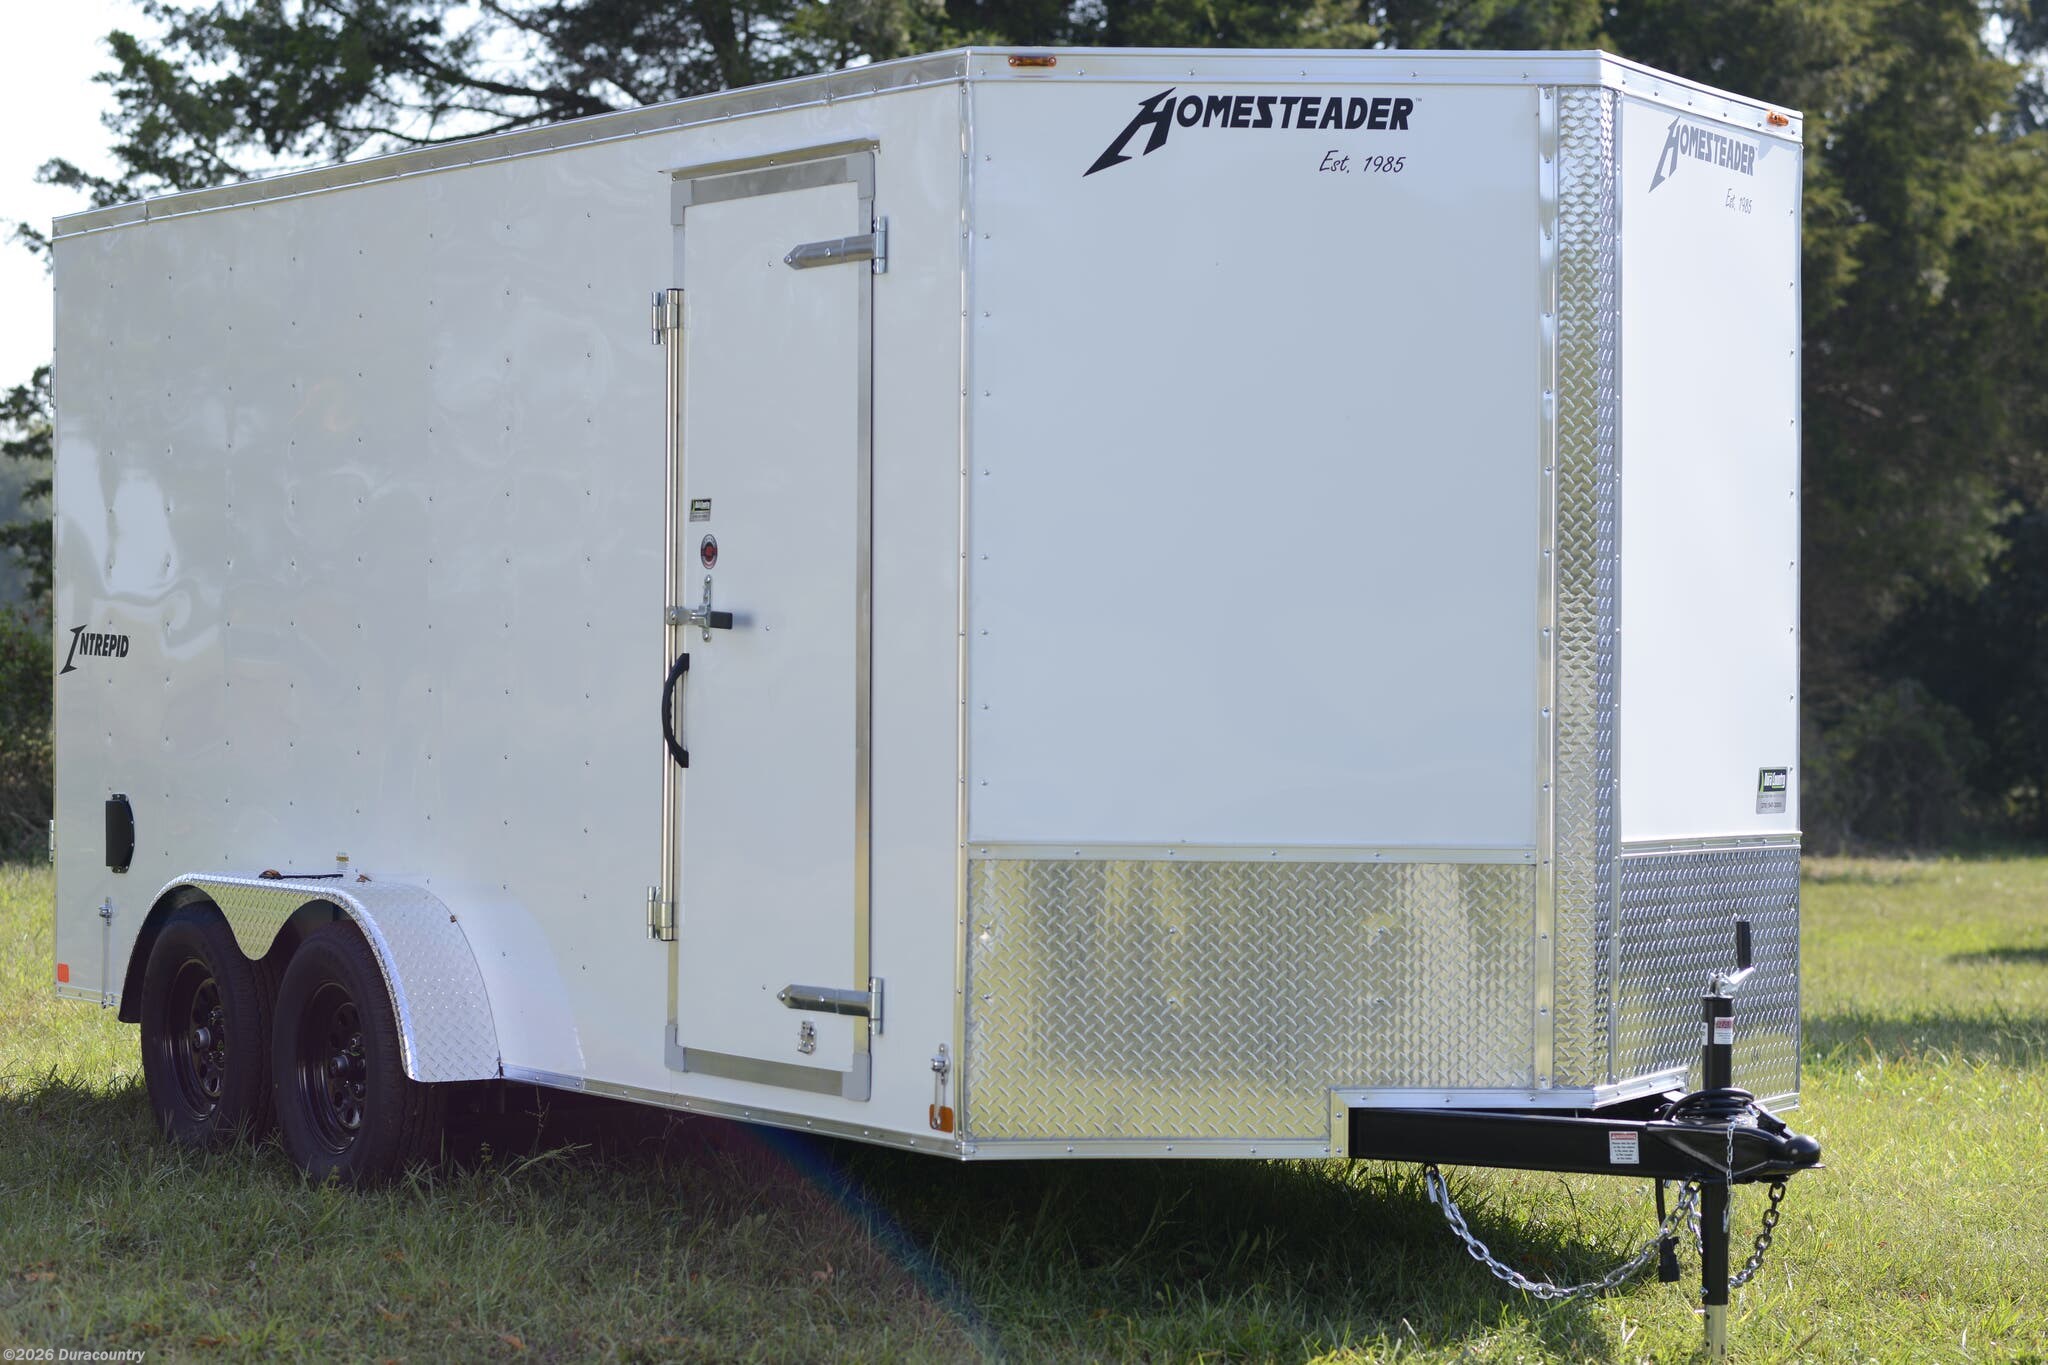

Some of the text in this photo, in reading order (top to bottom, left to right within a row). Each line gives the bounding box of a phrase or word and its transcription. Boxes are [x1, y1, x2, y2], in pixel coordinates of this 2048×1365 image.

[1082, 87, 1412, 177] HOMESTEADER
[1319, 150, 1406, 174] Est. 1985
[1648, 115, 1754, 193] HOMESTEADER
[59, 624, 129, 675] INTREPID
